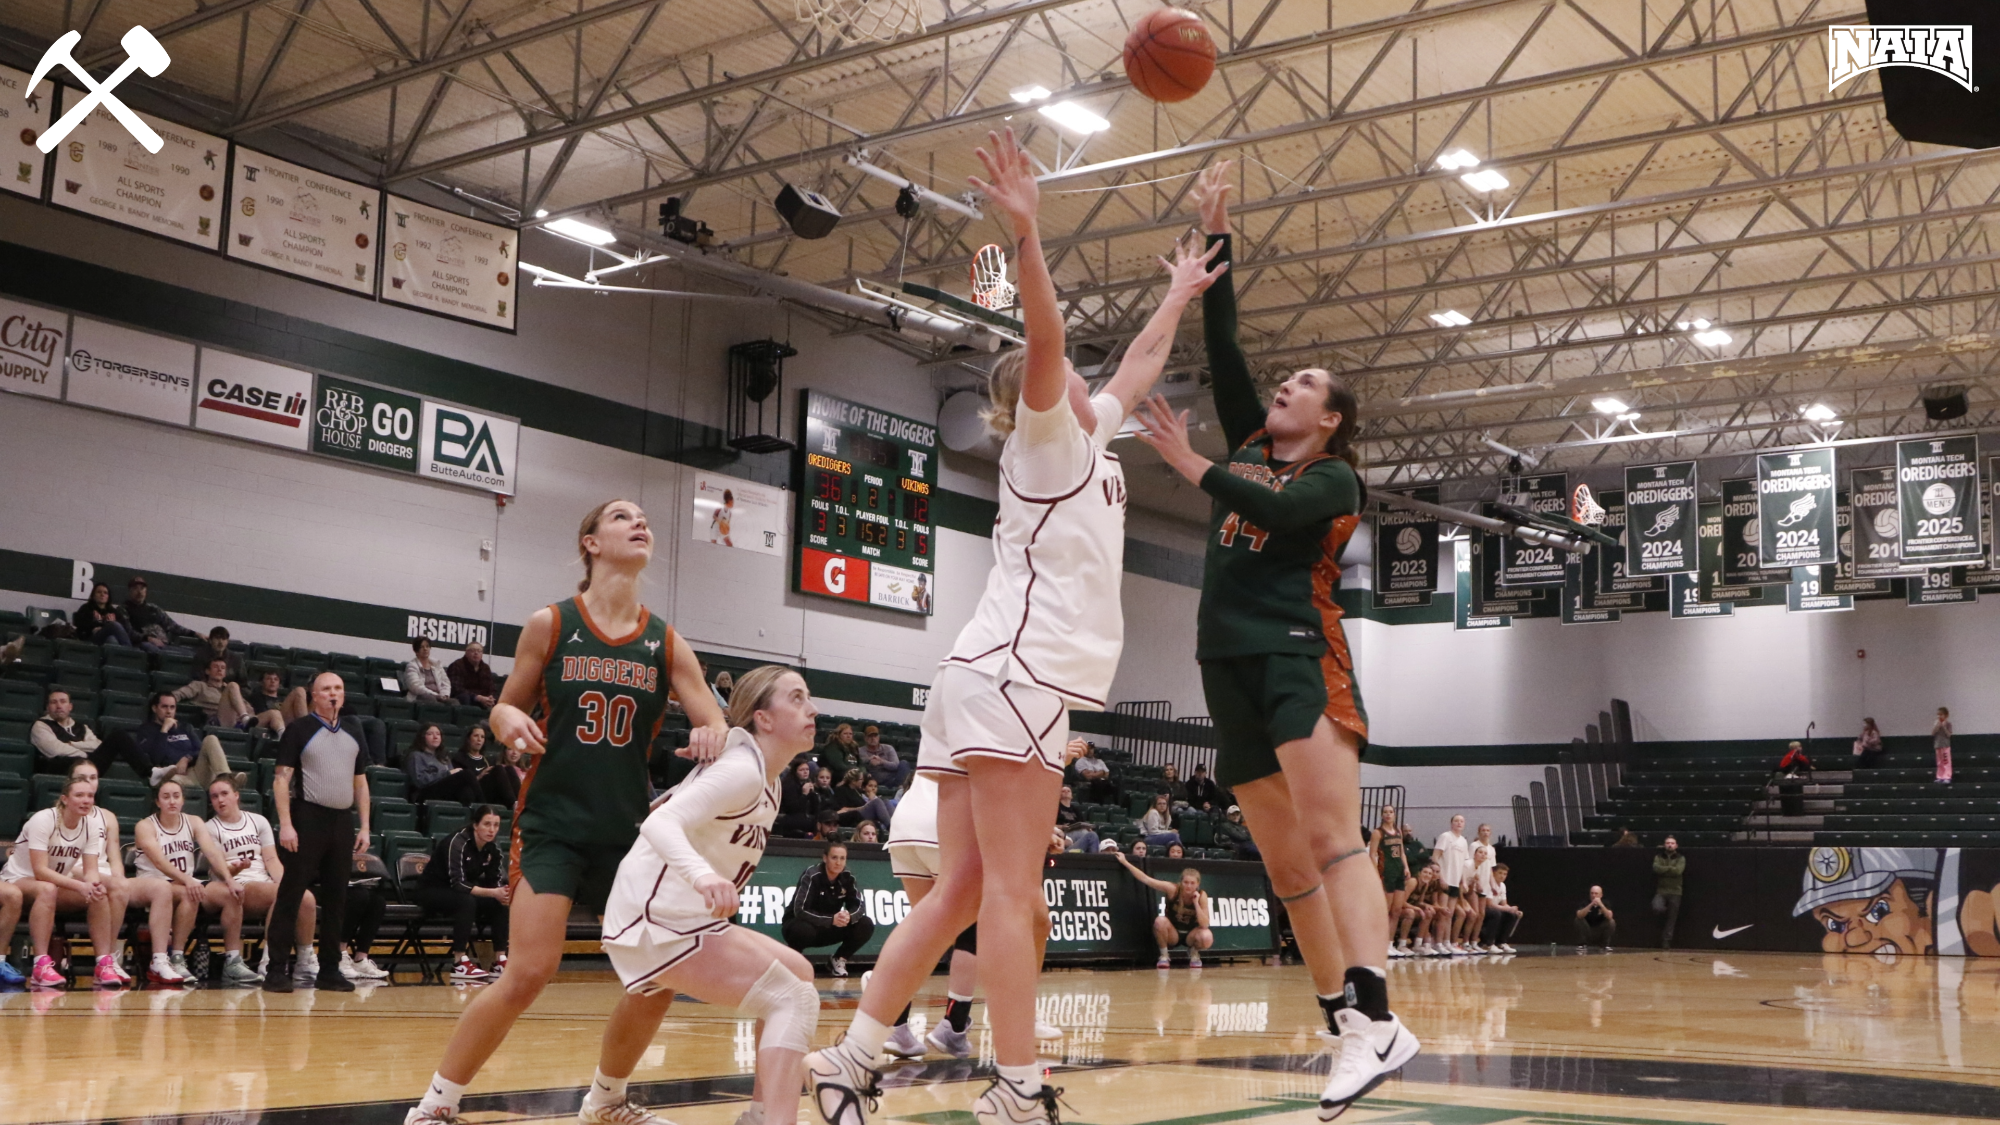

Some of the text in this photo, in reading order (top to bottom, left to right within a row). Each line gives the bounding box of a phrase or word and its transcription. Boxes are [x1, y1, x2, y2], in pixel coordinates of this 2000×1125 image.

[98, 140, 118, 153] 1989
[171, 163, 190, 176] 1990
[117, 176, 165, 197] ALL SPORTS
[264, 165, 299, 183] FRONTIER
[305, 179, 352, 200] CONFERENCE
[116, 188, 162, 209] CHAMPION
[266, 195, 284, 207] 1990
[331, 214, 346, 226] 1991
[413, 212, 446, 228] FRONTIER
[450, 223, 494, 241] CONFERENCE
[284, 228, 326, 247] ALL SPORTS
[415, 239, 432, 250] 1992
[282, 240, 323, 258] CHAMPION
[432, 270, 470, 286] ALL SPORTS
[431, 281, 468, 297] CHAMPION
[1, 315, 63, 367] City
[94, 358, 190, 388] TORGERSON'S
[95, 369, 189, 394] EQUIPMENT
[207, 378, 282, 414] CASE
[317, 407, 368, 435] CHOP
[372, 402, 413, 441] GO
[812, 394, 936, 447] HOME OF THE DIGGERS
[321, 428, 362, 449] HOUSE
[368, 439, 413, 459] DIGGERS
[808, 452, 852, 475] OREDIGGERS
[1911, 454, 1965, 465] MONTANA TECH
[430, 463, 505, 487] ButteAuto.com
[1770, 468, 1803, 477] MONTANA
[1901, 462, 1976, 482] OREDIGGERS
[864, 474, 883, 487] PERIOD
[901, 477, 930, 495] VIKINGS
[1637, 478, 1685, 489] MONTANA TECH
[1761, 474, 1831, 494] OREDIGGERS
[1864, 483, 1895, 491] MONTANA
[1628, 486, 1694, 505] OREDIGGERS
[1855, 491, 1899, 507] OREDIG
[811, 499, 829, 511] FOULS
[1926, 499, 1952, 509] MEN'S
[856, 510, 889, 525] PLAYER FOUL
[913, 523, 929, 535] FOULS
[1917, 517, 1963, 536] 2025
[810, 534, 828, 546] SCORE
[1776, 529, 1820, 548] 2024
[862, 545, 880, 557] MATCH
[1516, 548, 1554, 565] 2024
[1641, 539, 1683, 558] 2024
[1776, 551, 1821, 561] CHAMPIONS
[1868, 543, 1899, 558] 201
[912, 556, 929, 568] SCORE
[1391, 560, 1427, 576] 2023
[1641, 560, 1684, 570] CHAMPIONS
[1737, 552, 1757, 568] 20
[71, 560, 94, 600] B
[824, 557, 846, 594] G
[1390, 580, 1427, 589] CHAMPIONS
[1612, 581, 1652, 590] CHAMPIONS
[1801, 580, 1819, 595] 19
[1834, 582, 1876, 591] CHAMPIONS
[878, 592, 910, 606] BARRICK
[1384, 595, 1420, 604] CHAMPIONS
[1495, 589, 1532, 598] CHAMPIONS
[1711, 590, 1750, 599] CHAMPIONS
[1921, 593, 1963, 601] CHAMPIONS
[1482, 605, 1518, 613] CHAMPIONS
[1683, 606, 1720, 615] CHAMPIONS
[1801, 600, 1840, 608] CHAMPIONS
[1466, 619, 1501, 627] CHAMPIONS
[1573, 613, 1608, 621] CHAMPIONS
[407, 615, 488, 647] RESERVED
[561, 656, 658, 693] DIGGERS
[576, 690, 637, 747] 30
[1043, 878, 1109, 908] OF THE
